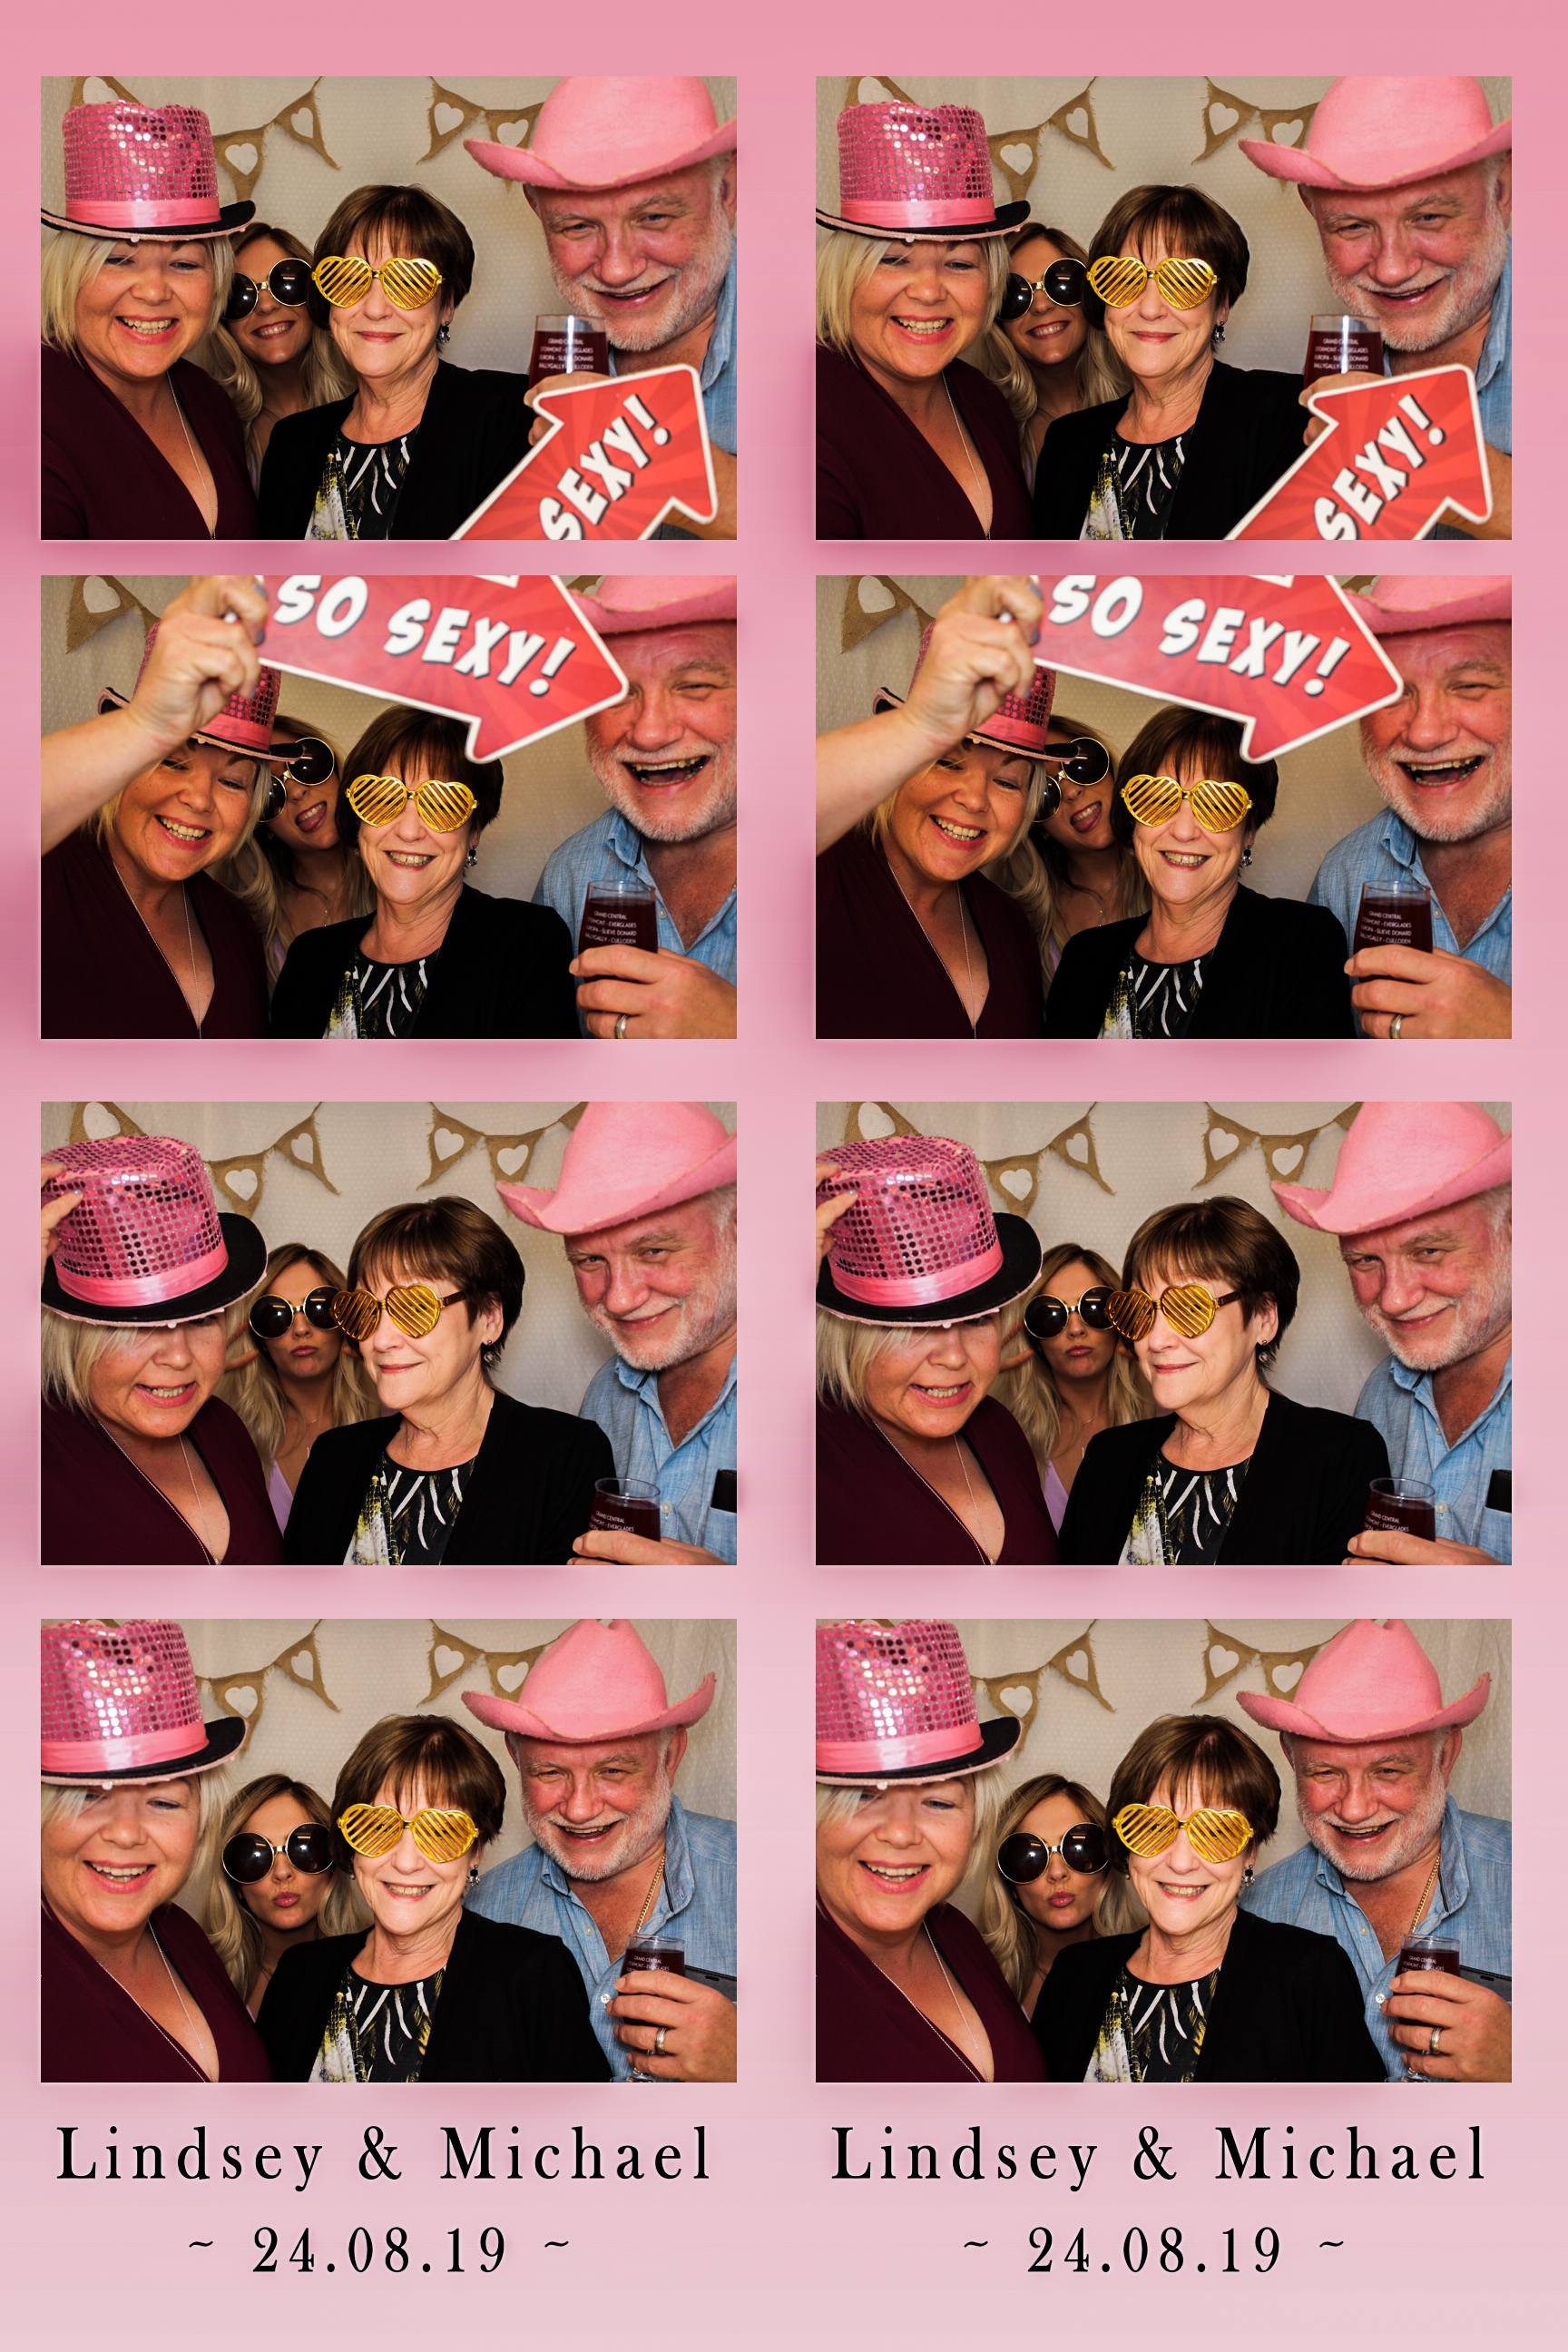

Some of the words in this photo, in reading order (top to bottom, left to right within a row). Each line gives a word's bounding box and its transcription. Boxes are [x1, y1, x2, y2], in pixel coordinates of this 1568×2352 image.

[539, 394, 670, 540] SEXY!
[1314, 394, 1445, 540] SEXY!
[273, 575, 368, 638] SO
[383, 598, 576, 697] SEXY!
[1048, 575, 1143, 638] SO
[1158, 598, 1351, 697] SEXY!
[593, 910, 607, 918] GRAND
[1368, 910, 1382, 918] GRAND
[606, 1514, 625, 1524] CENTRAL
[1381, 1514, 1400, 1524] CENTRAL
[607, 1523, 634, 1532] EVERGLADES
[1382, 1523, 1409, 1532] EVERGLADES
